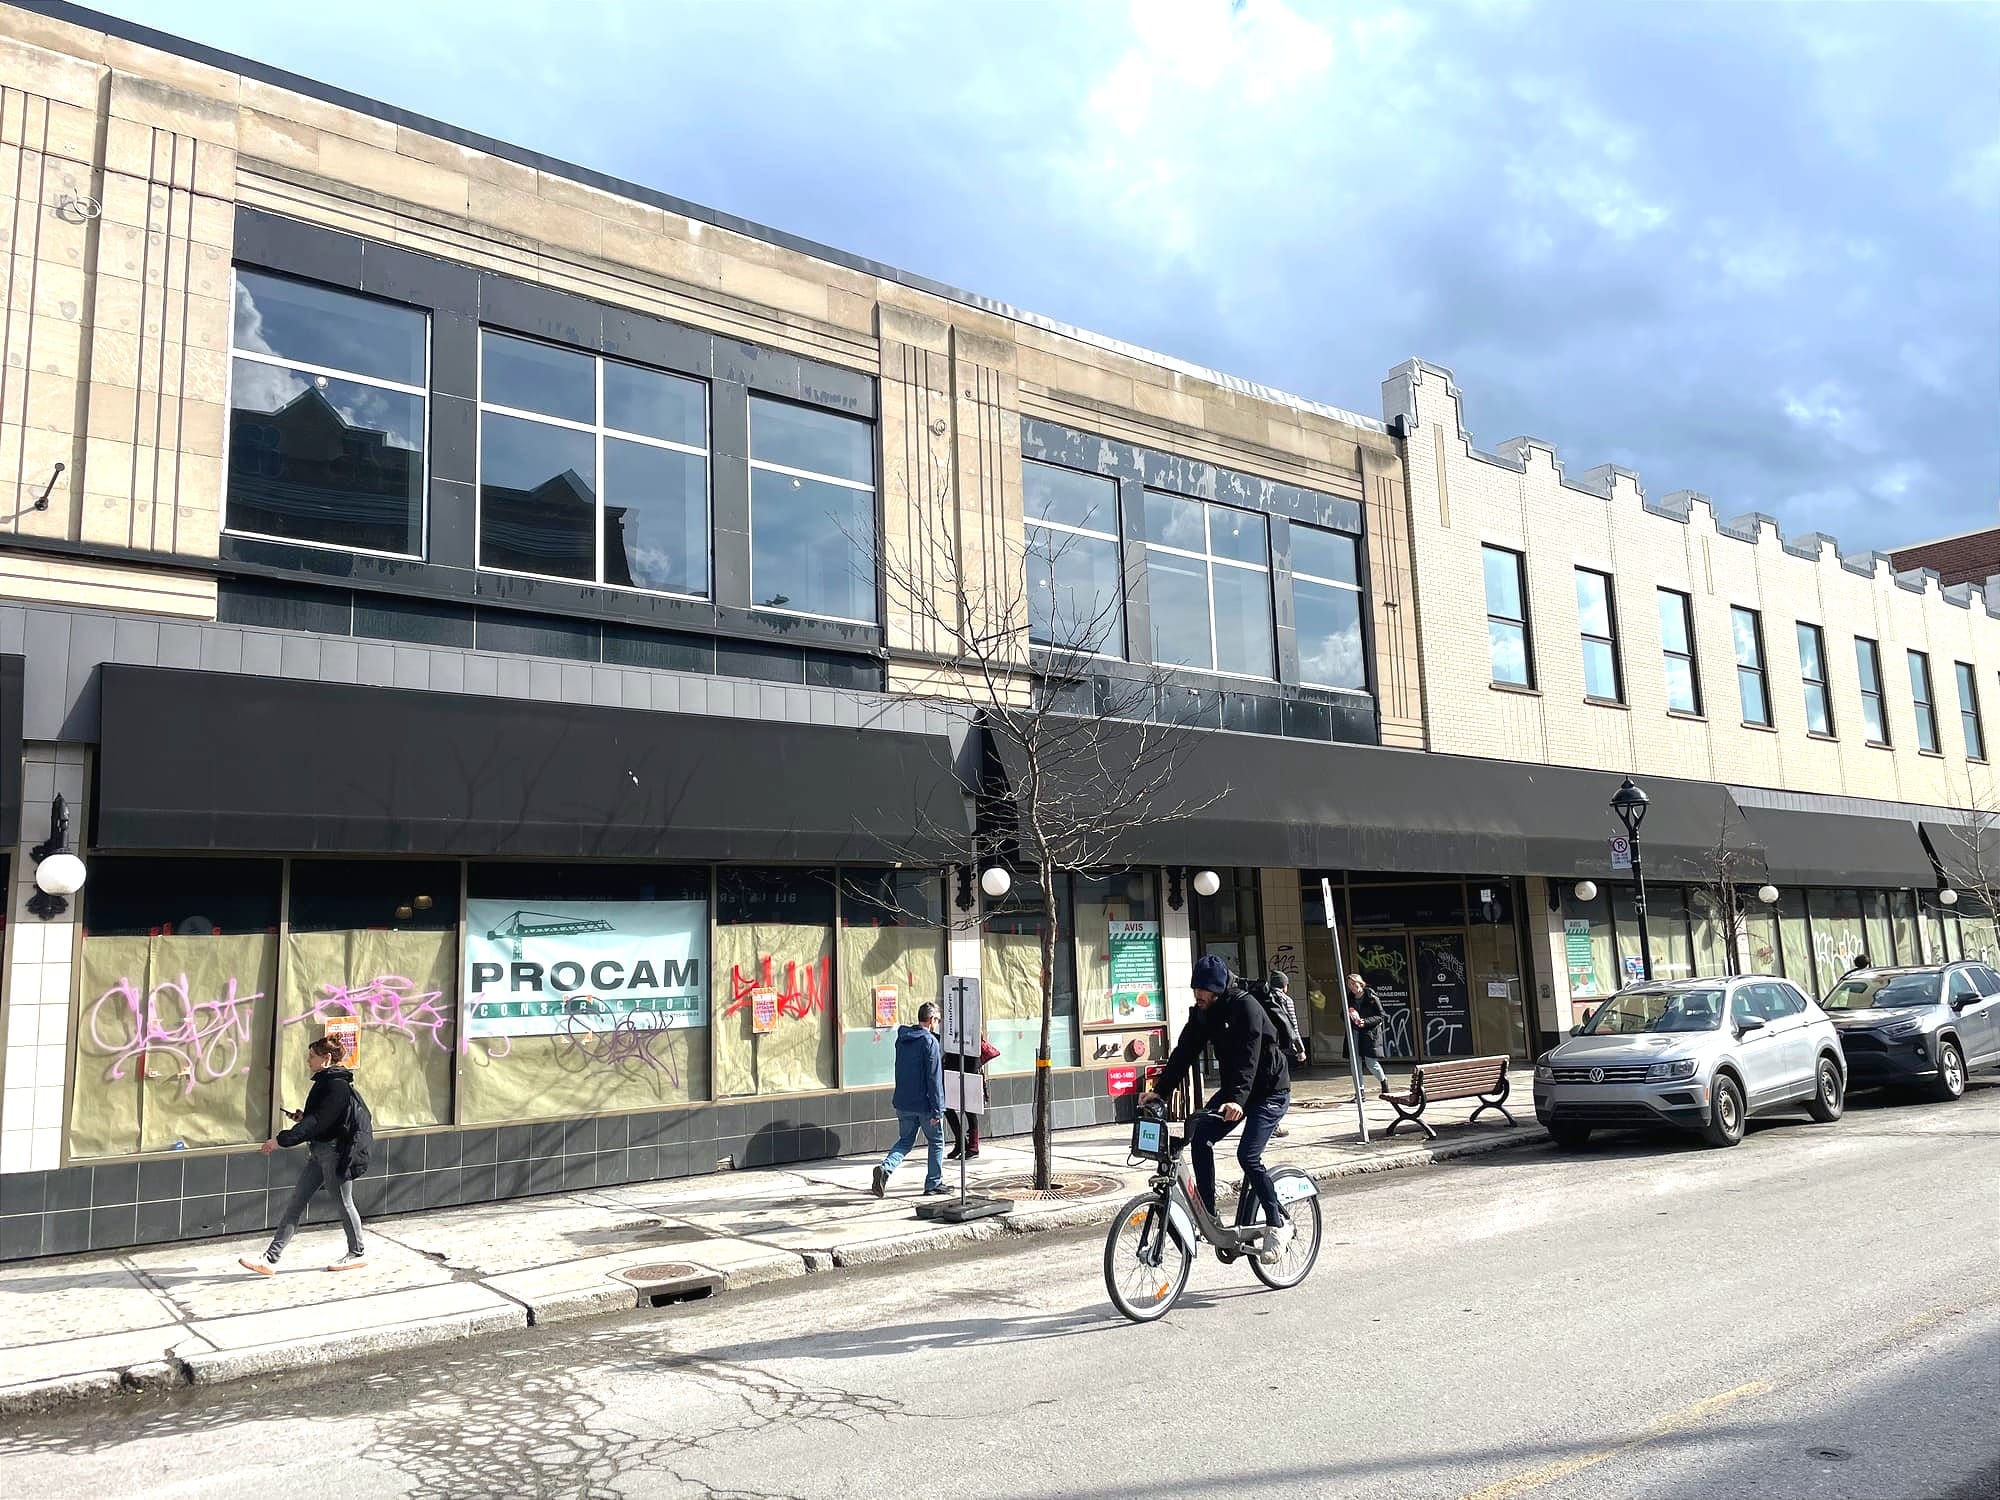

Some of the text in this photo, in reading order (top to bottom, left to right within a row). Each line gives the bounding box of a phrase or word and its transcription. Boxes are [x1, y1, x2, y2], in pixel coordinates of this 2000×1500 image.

[1124, 923, 1144, 931] AVIS
[471, 958, 699, 992] PROCAM
[480, 997, 691, 1017] CONSTRUCTION
